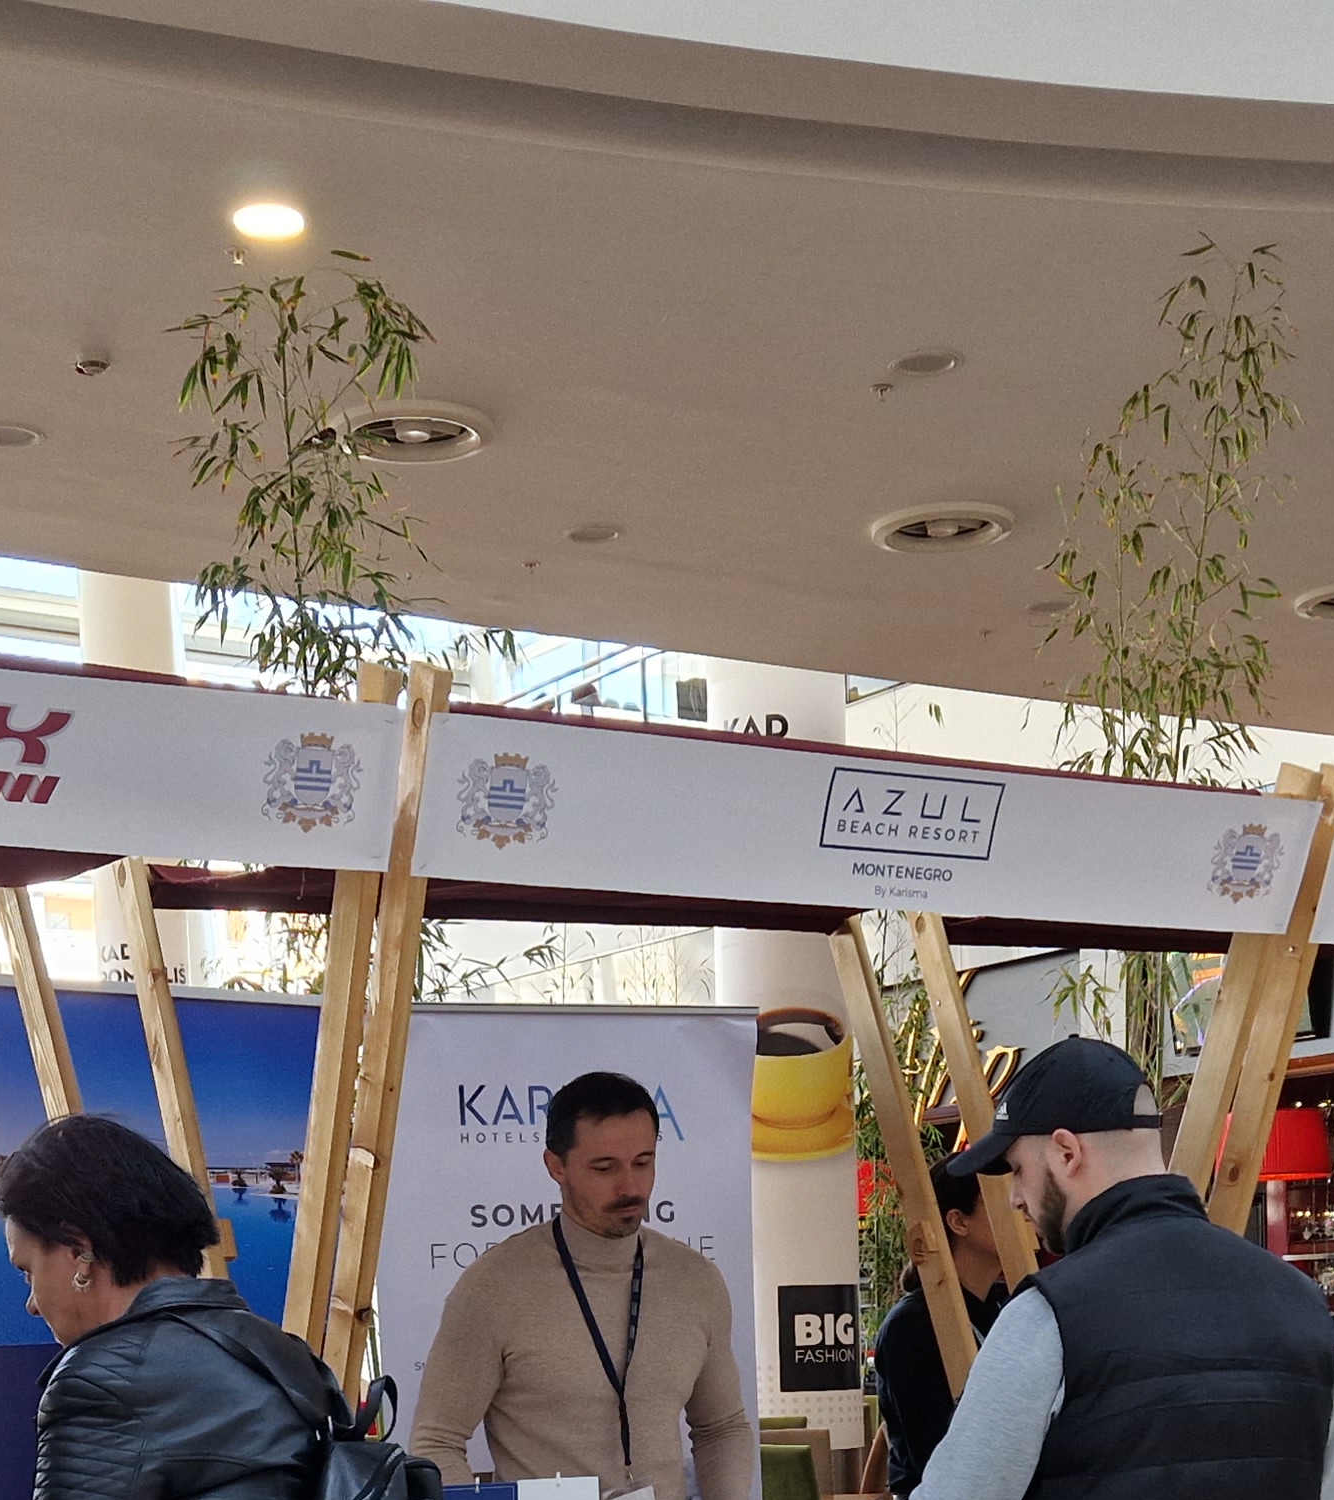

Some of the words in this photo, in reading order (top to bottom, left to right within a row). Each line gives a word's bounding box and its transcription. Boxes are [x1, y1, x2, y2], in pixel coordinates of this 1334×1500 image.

[842, 786, 982, 824] AZUL
[836, 818, 900, 837] BEACH
[908, 825, 981, 844] RESORT
[851, 861, 954, 883] MONTENEGRO
[874, 884, 887, 898] By
[889, 886, 929, 899] Karisma
[458, 1083, 685, 1142] KARA
[460, 1131, 540, 1144] HOTELS
[794, 1313, 855, 1347] BIG
[795, 1348, 855, 1364] FASHION
